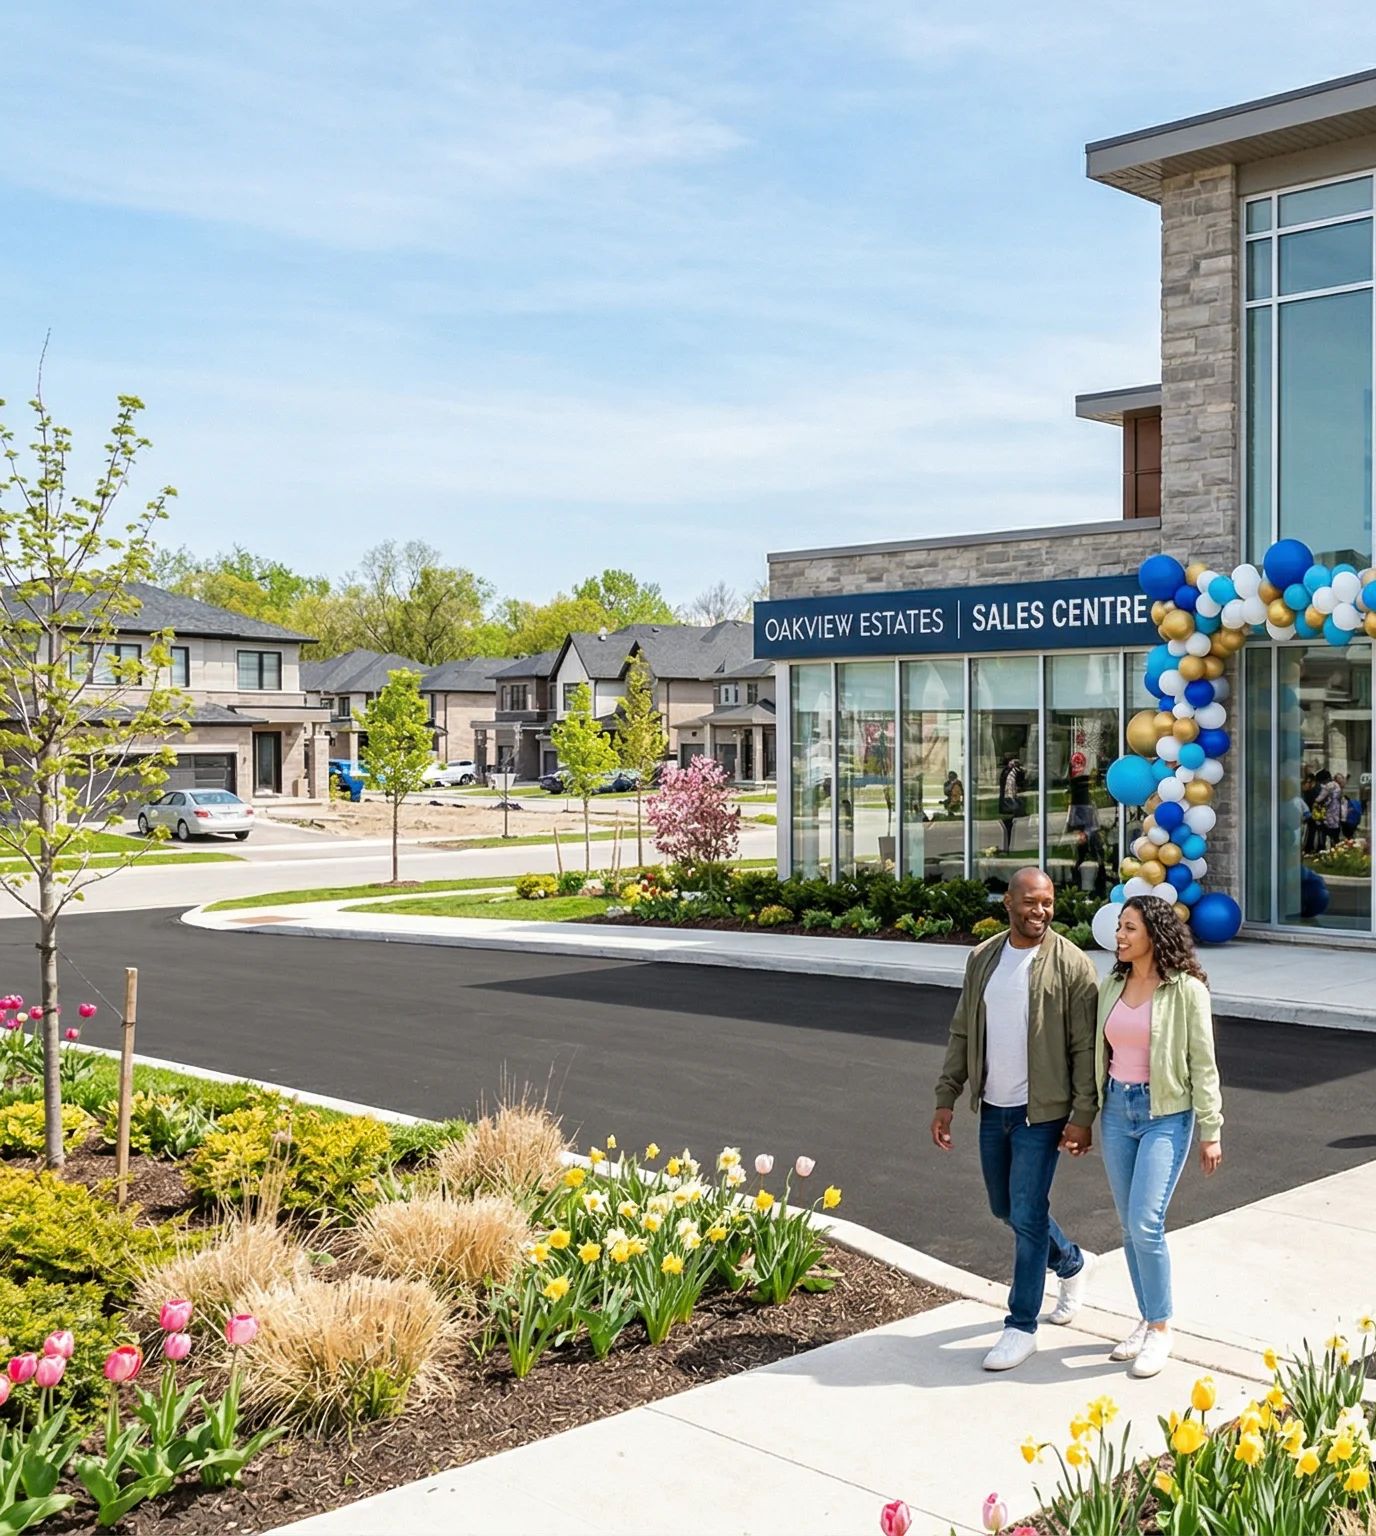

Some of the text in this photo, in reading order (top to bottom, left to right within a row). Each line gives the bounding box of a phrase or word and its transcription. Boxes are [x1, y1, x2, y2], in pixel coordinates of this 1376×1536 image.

[765, 594, 1148, 642] OAKVIEW ESTATES SALES CENTRE
